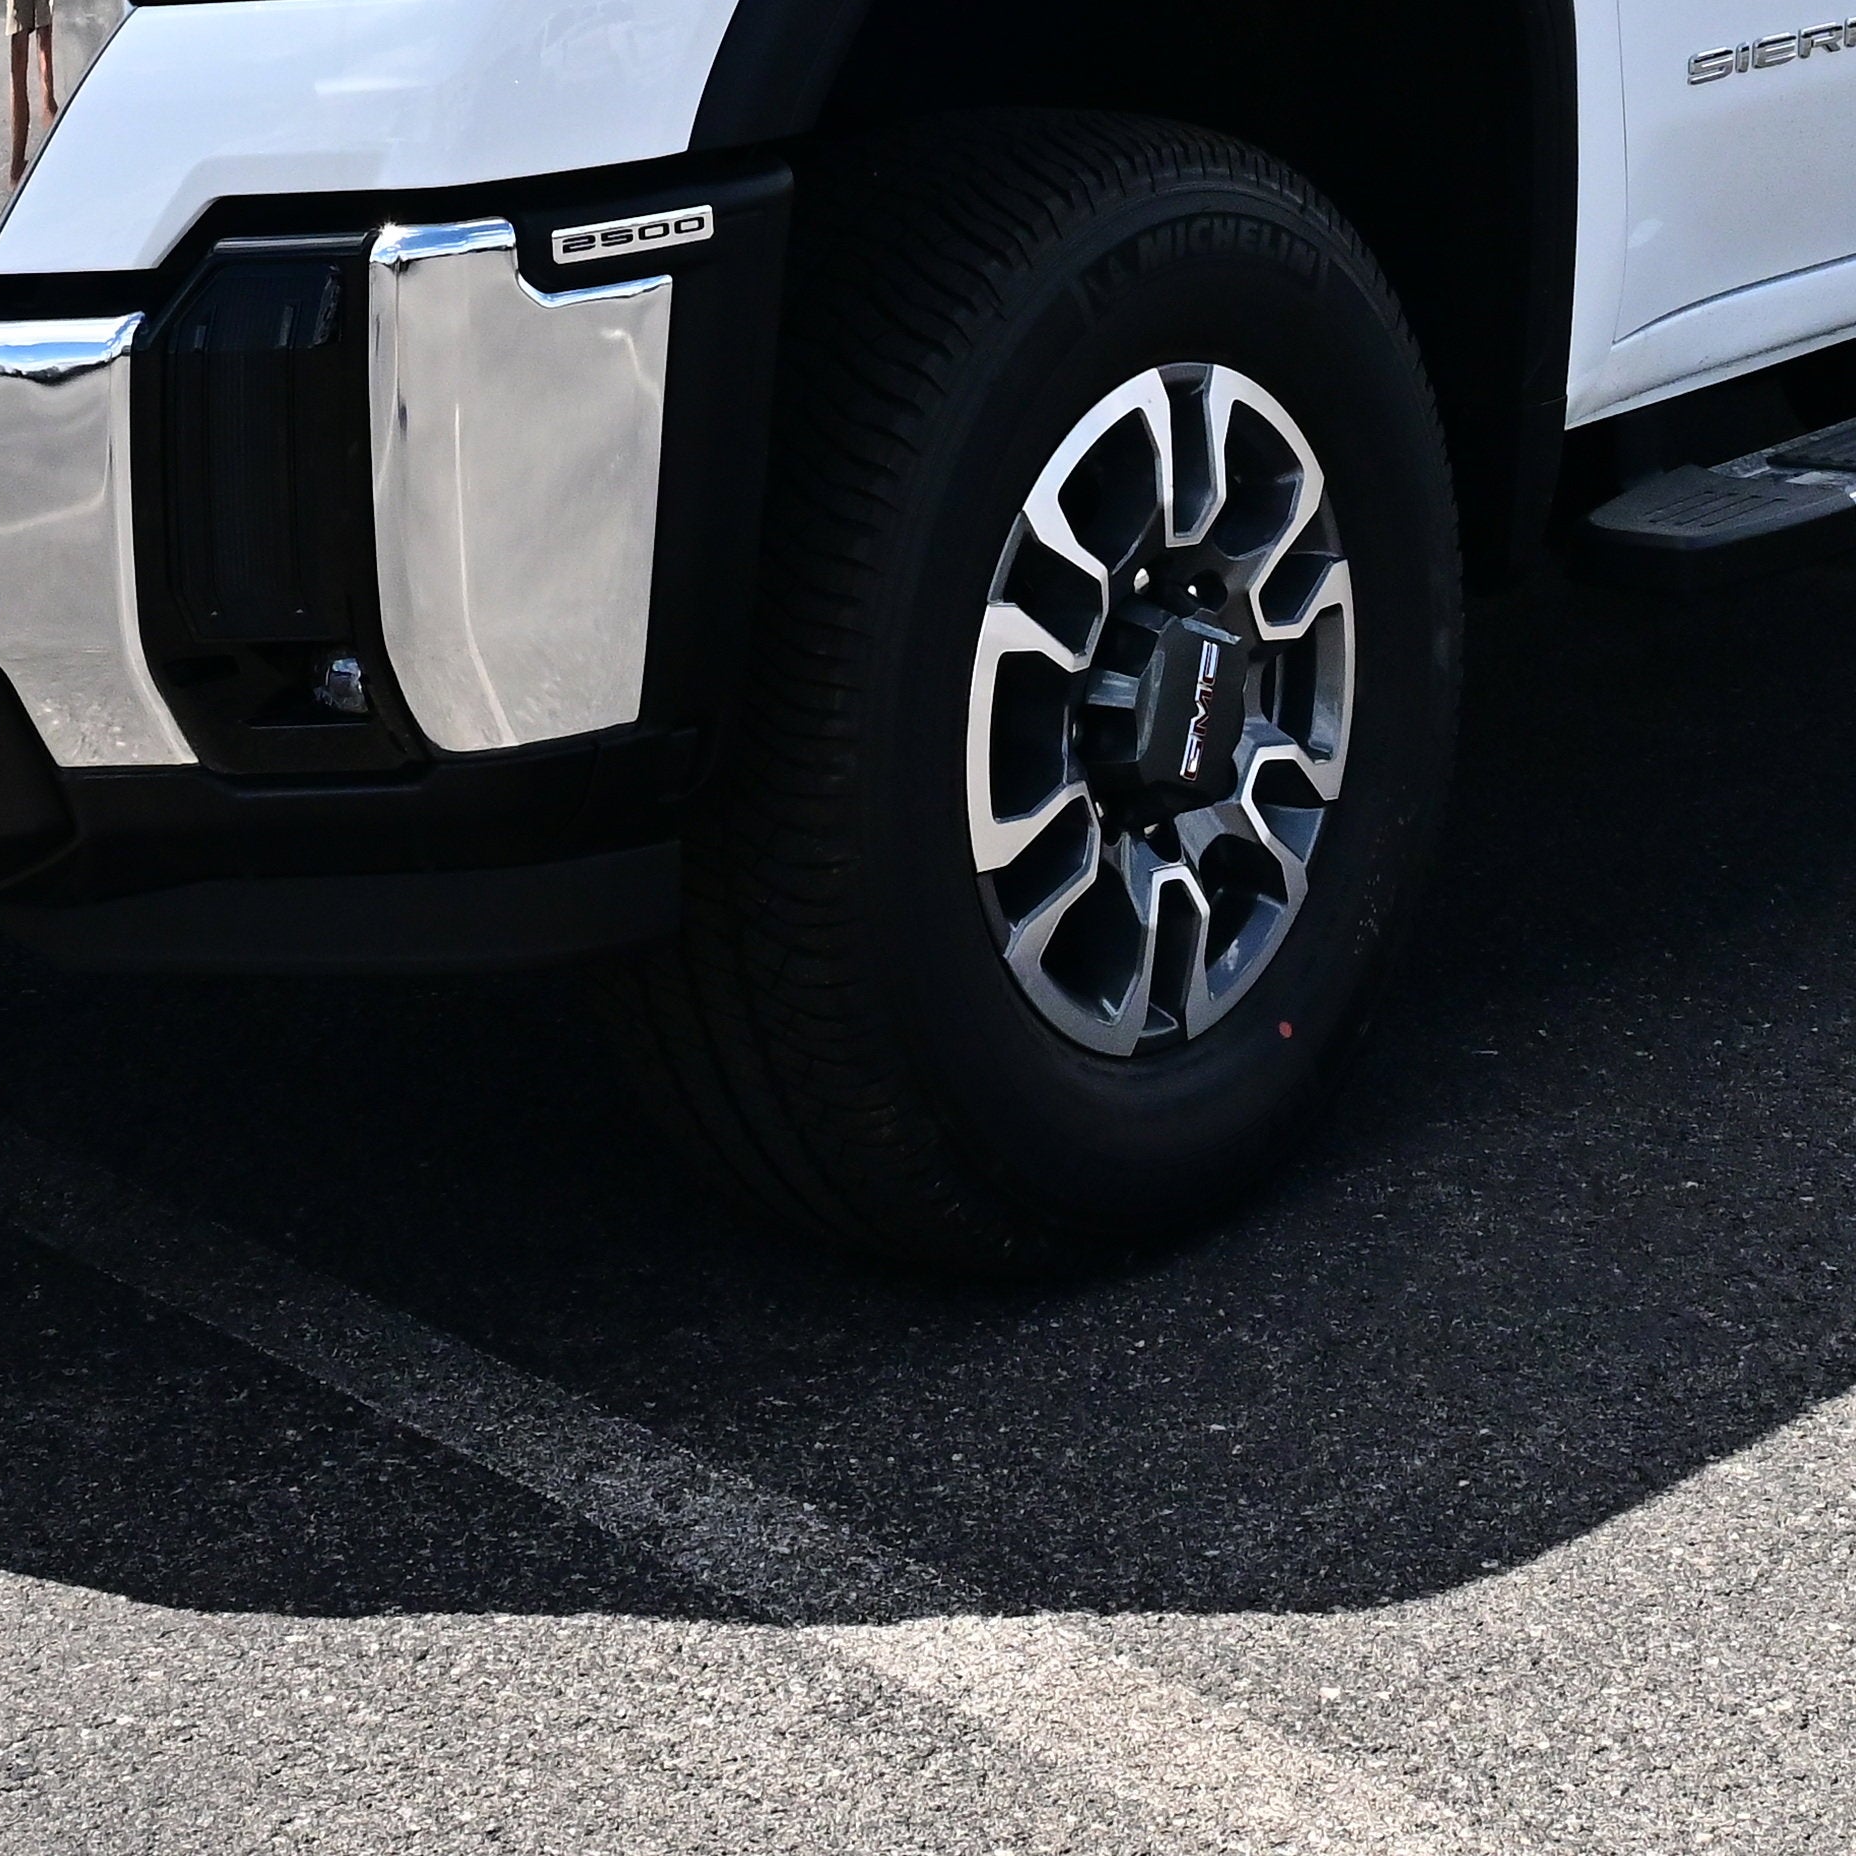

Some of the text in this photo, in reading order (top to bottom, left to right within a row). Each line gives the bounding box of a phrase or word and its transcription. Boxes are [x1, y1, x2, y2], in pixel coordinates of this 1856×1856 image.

[561, 215, 706, 255] 2500
[1137, 215, 1318, 280] MICHELIN
[1179, 639, 1221, 782] GMC
